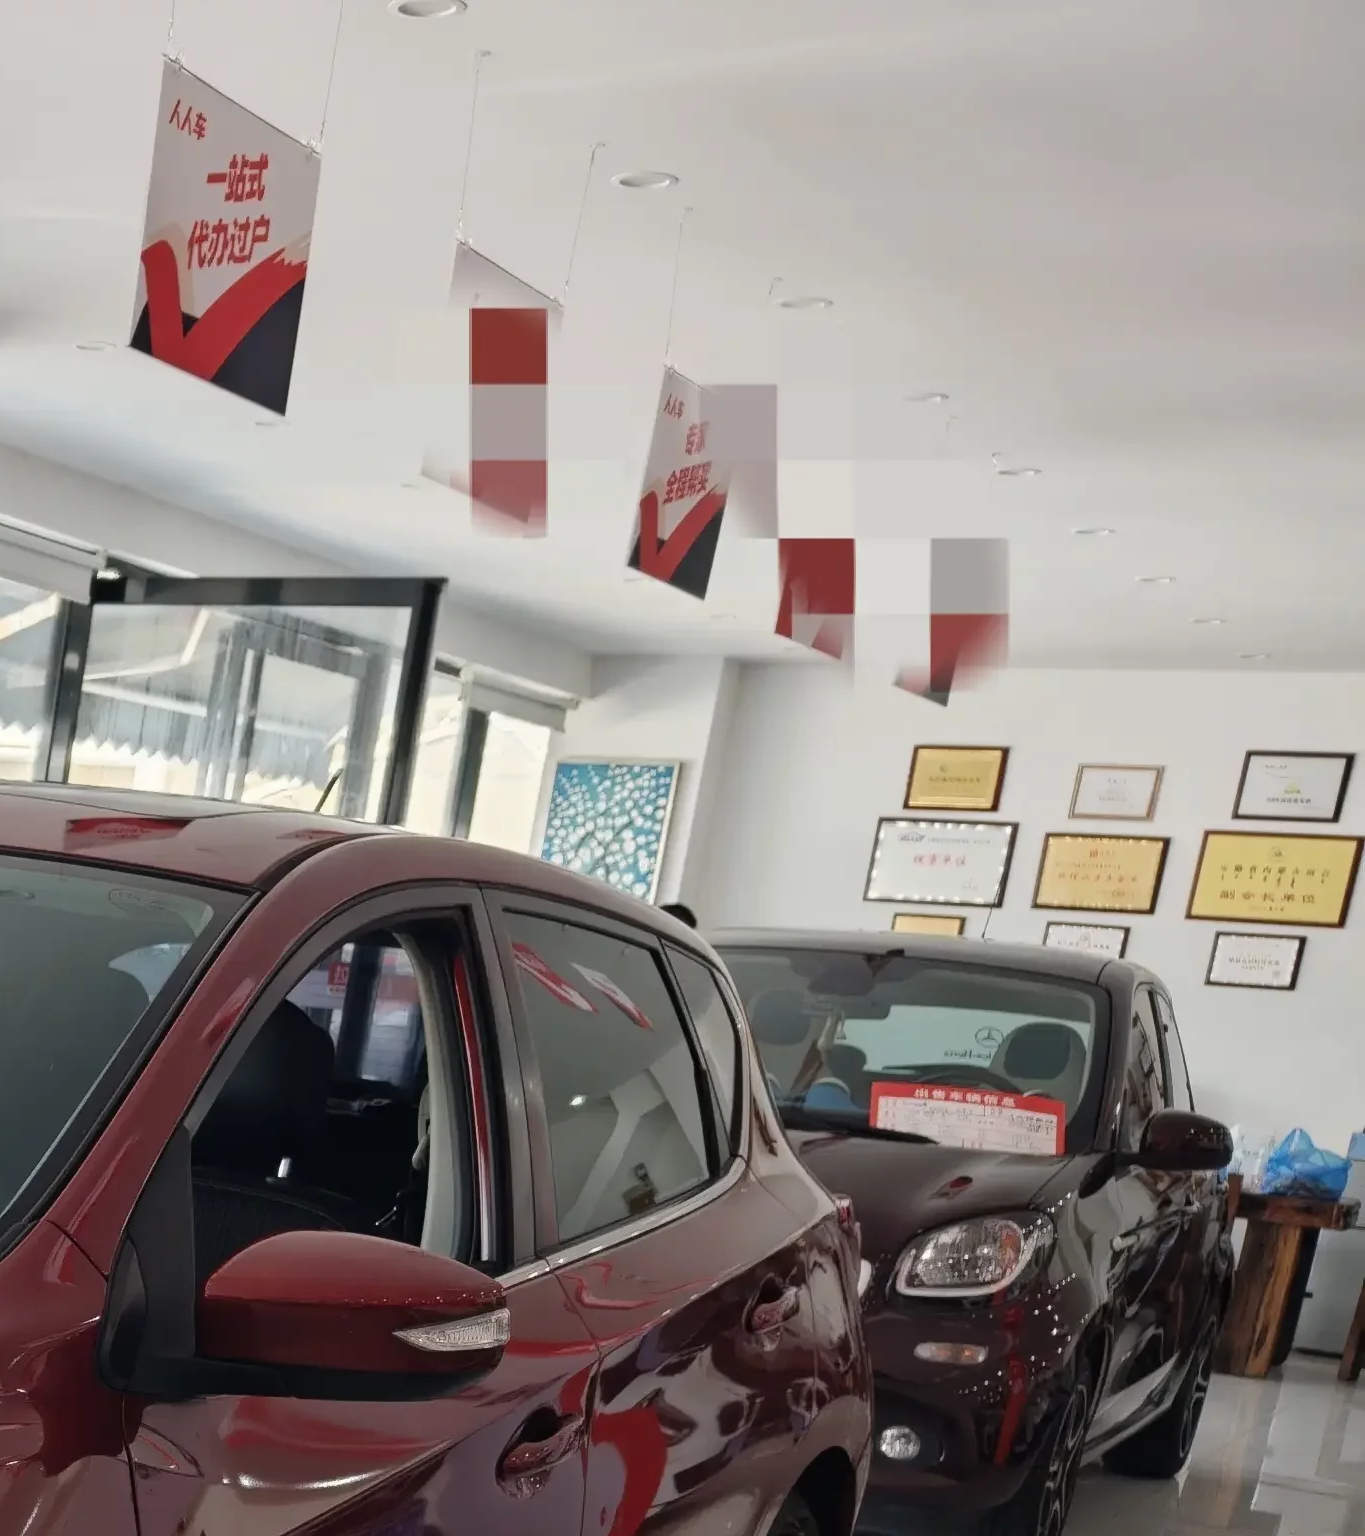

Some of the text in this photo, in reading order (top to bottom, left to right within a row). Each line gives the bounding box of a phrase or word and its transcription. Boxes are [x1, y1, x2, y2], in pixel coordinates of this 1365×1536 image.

[169, 99, 207, 140] 人人车
[206, 153, 268, 202] 一站式
[188, 214, 270, 270] 代办过户
